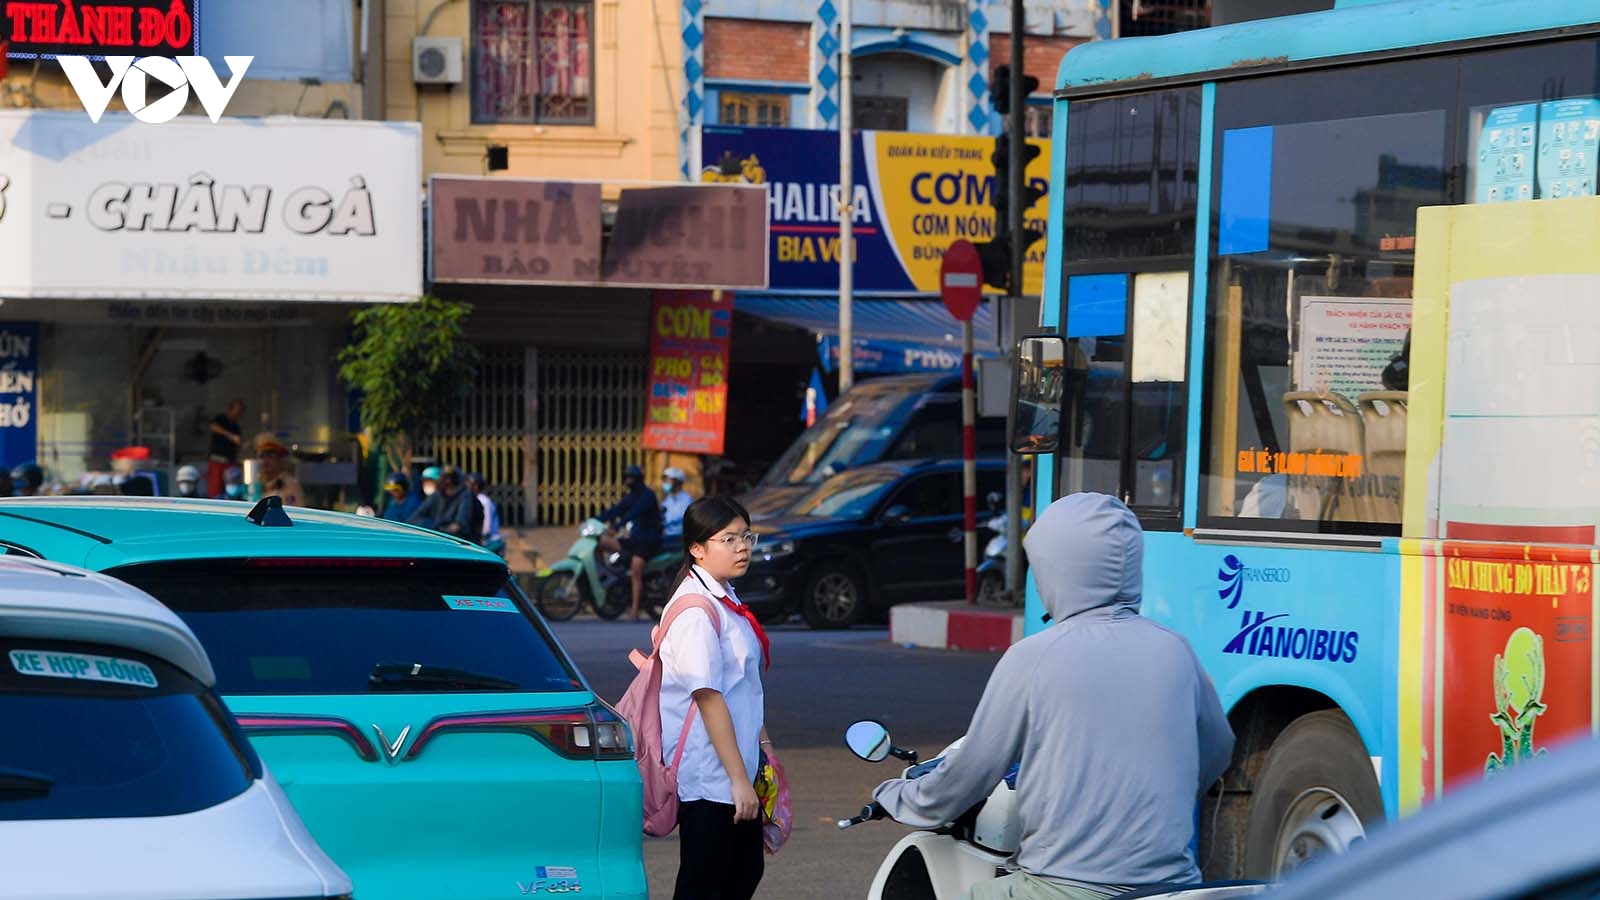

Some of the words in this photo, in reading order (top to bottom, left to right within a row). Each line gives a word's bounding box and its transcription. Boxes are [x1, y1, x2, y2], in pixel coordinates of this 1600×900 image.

[6, 0, 134, 46] THÀNH
[138, 0, 193, 49] ĐÔ
[953, 148, 983, 161] TRANG
[911, 169, 996, 206] CƠM
[86, 170, 273, 233] CHÂN
[283, 174, 377, 236] GÀ
[454, 187, 582, 245] NHÀ
[913, 213, 950, 236] CƠM
[955, 211, 993, 237] NÓN
[777, 235, 817, 263] BIA
[573, 256, 713, 283] NUYỆT
[1243, 567, 1290, 583] TRANSERCO
[455, 599, 474, 607] XE
[1222, 610, 1359, 664] HANOIBUS
[13, 653, 45, 672] XE
[47, 655, 88, 679] HỢP
[93, 657, 154, 685] ĐỒNG
